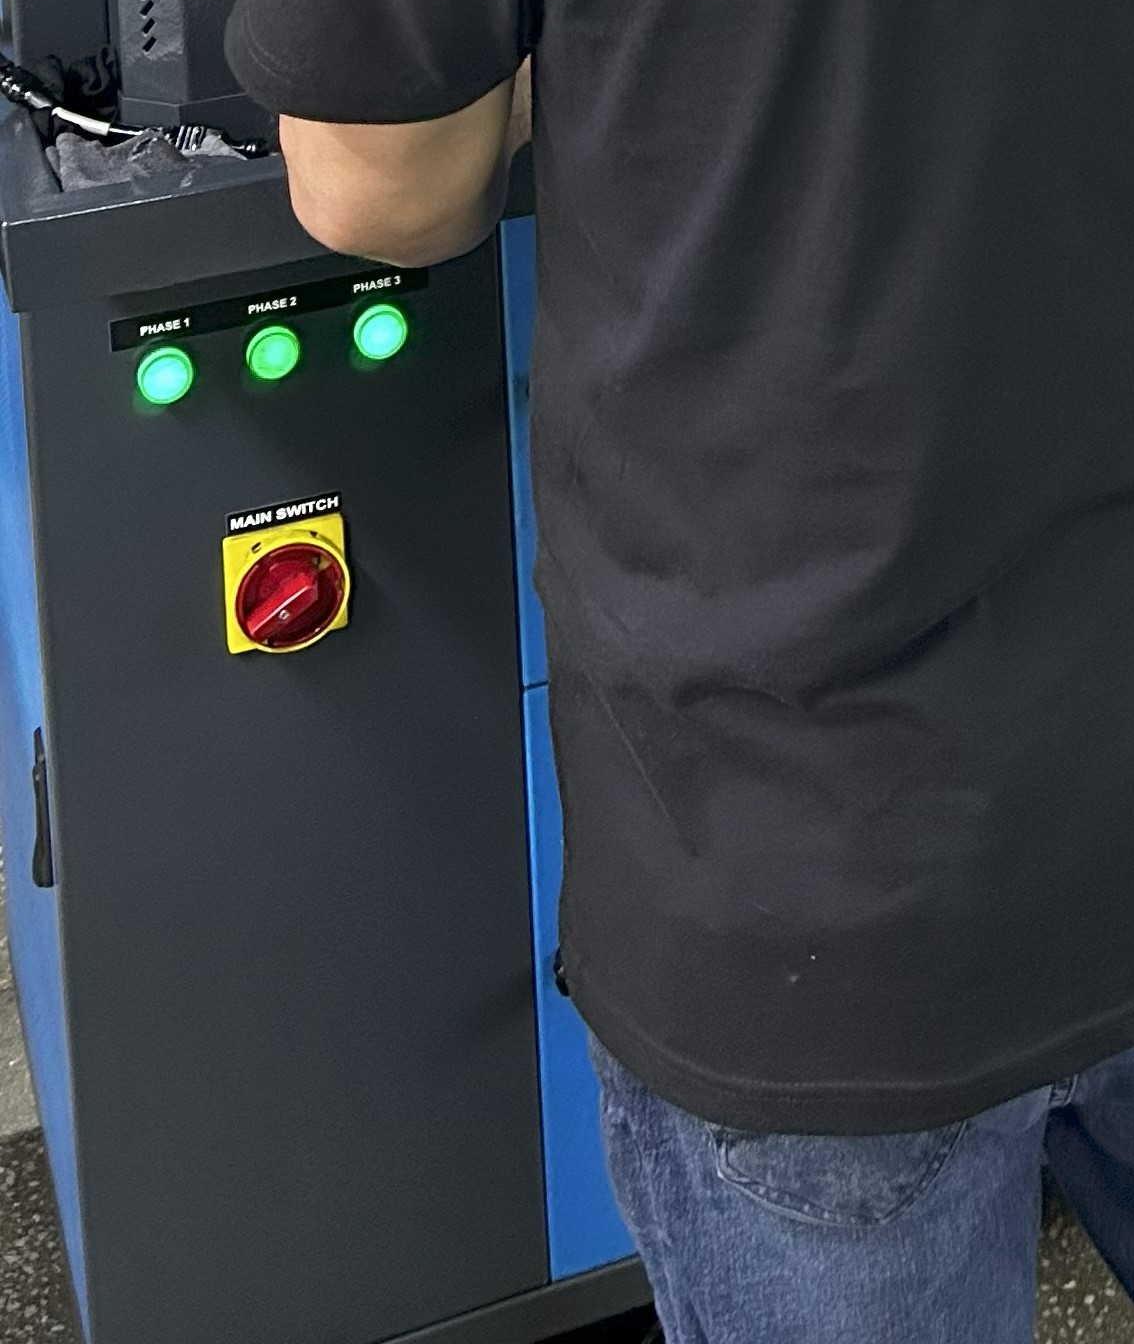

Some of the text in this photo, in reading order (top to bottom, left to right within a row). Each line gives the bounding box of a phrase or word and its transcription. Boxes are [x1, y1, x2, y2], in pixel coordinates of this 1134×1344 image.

[353, 275, 401, 294] PHASE 3
[247, 296, 297, 315] PHASE 2
[139, 317, 191, 337] PHASE 1
[230, 496, 339, 531] MAIN SWITCH
